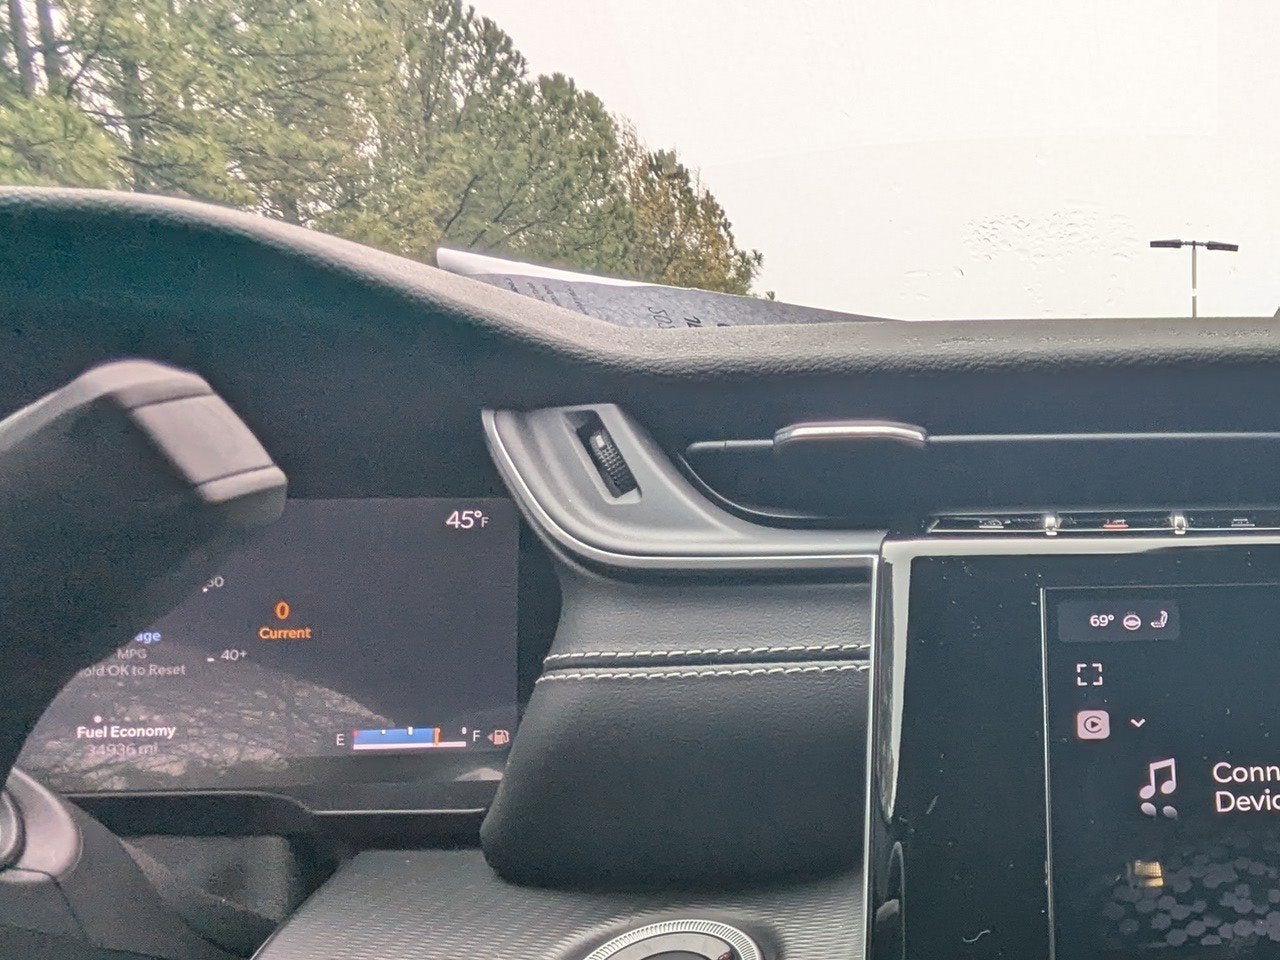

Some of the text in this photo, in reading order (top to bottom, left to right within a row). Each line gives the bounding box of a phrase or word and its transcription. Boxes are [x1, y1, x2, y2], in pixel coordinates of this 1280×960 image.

[275, 601, 290, 620] 0
[1089, 614, 1115, 628] 69°
[259, 627, 312, 640] Current
[117, 649, 147, 660] MPG
[108, 664, 130, 677] OK
[132, 665, 146, 676] to
[149, 664, 187, 676] Reset
[77, 725, 177, 740] Fuel Economy
[473, 730, 481, 742] F
[336, 733, 345, 747] E
